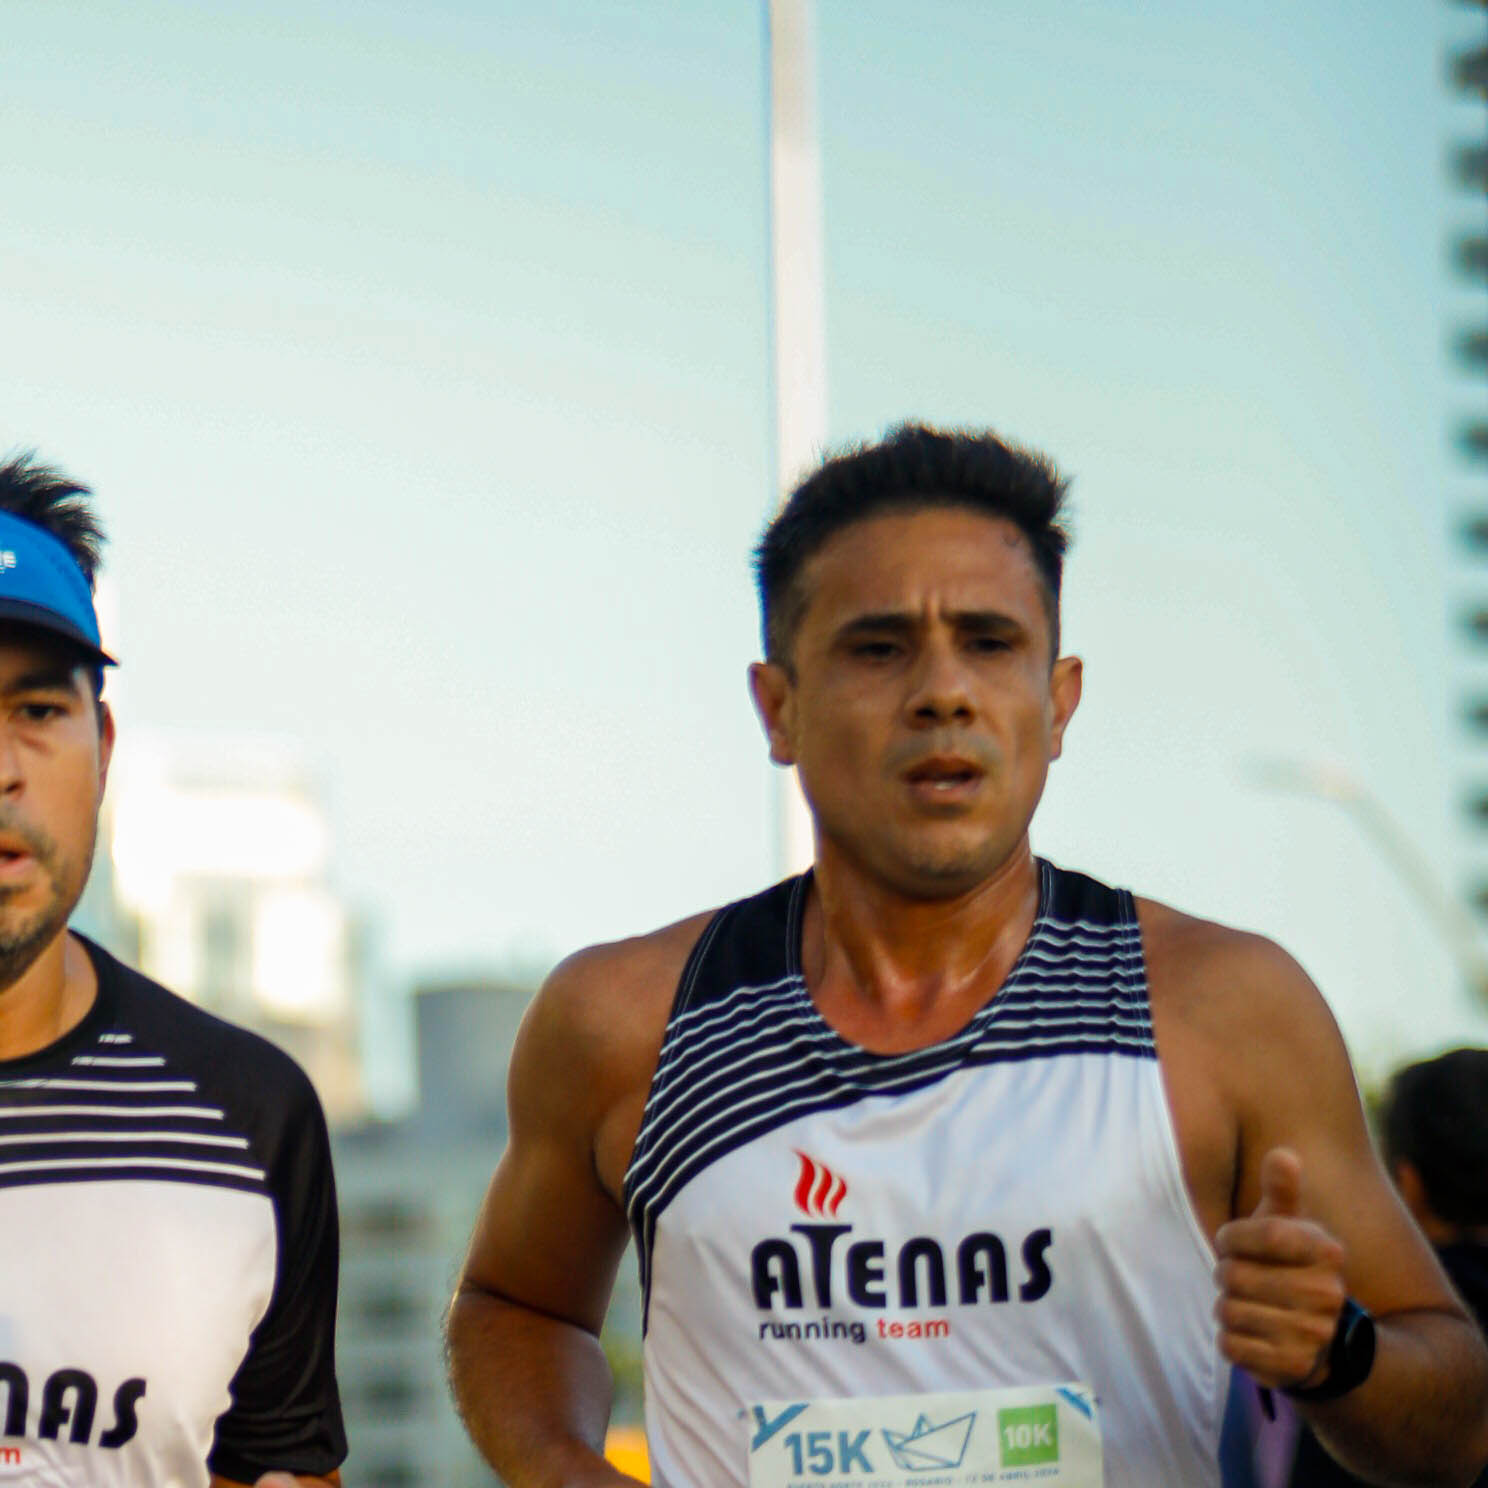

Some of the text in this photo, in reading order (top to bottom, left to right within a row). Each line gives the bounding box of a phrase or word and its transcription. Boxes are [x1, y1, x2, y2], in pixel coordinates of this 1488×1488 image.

[751, 1223, 1054, 1310] ATENAS
[759, 1317, 950, 1344] running team
[784, 1428, 874, 1476] 15K
[1004, 1422, 1053, 1449] 10K
